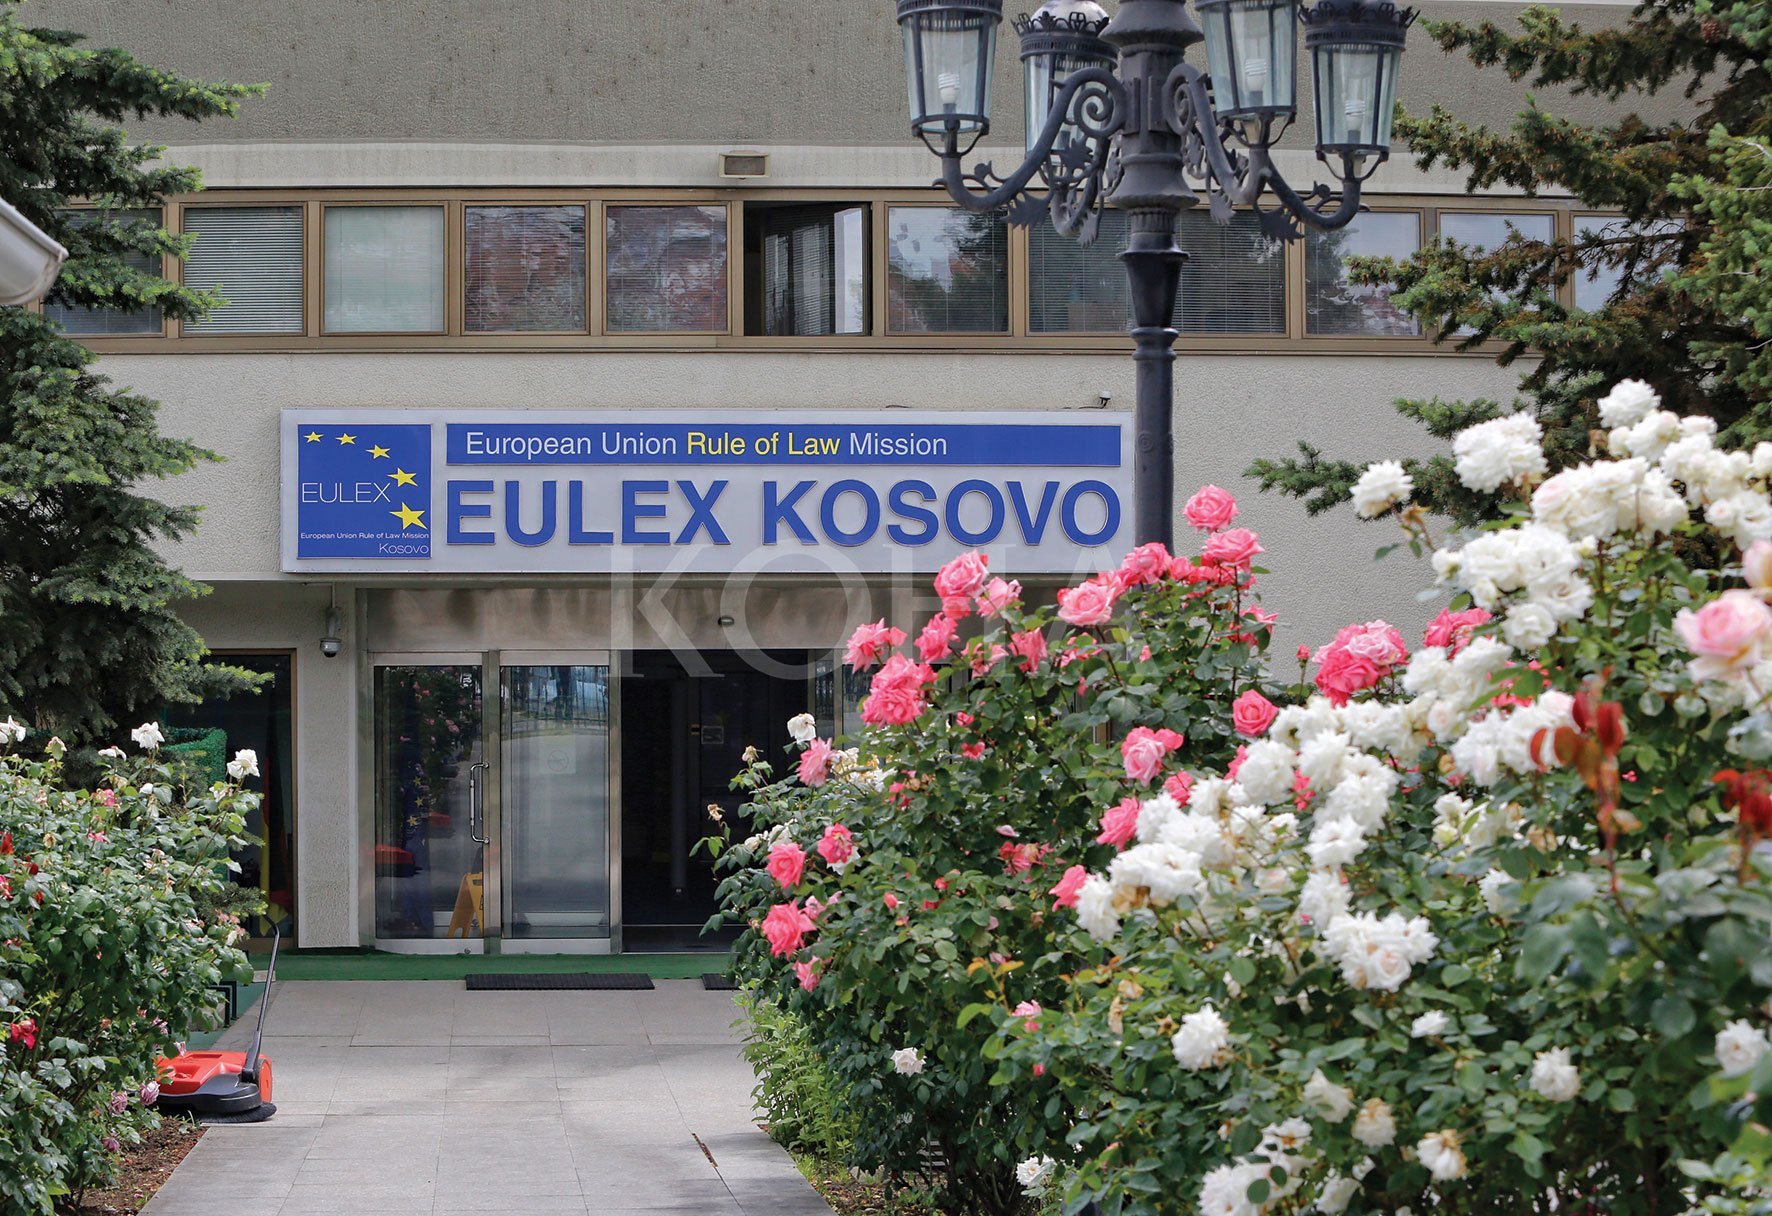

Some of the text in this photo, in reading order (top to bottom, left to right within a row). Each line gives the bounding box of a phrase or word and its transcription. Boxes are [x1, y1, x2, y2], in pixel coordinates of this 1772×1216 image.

[466, 431, 948, 460] European Union Rule of Law Mission
[301, 482, 391, 503] EULEX
[446, 479, 1121, 547] EULEX KOSOVO
[300, 532, 336, 540] European
[379, 543, 429, 554] Kosovo
